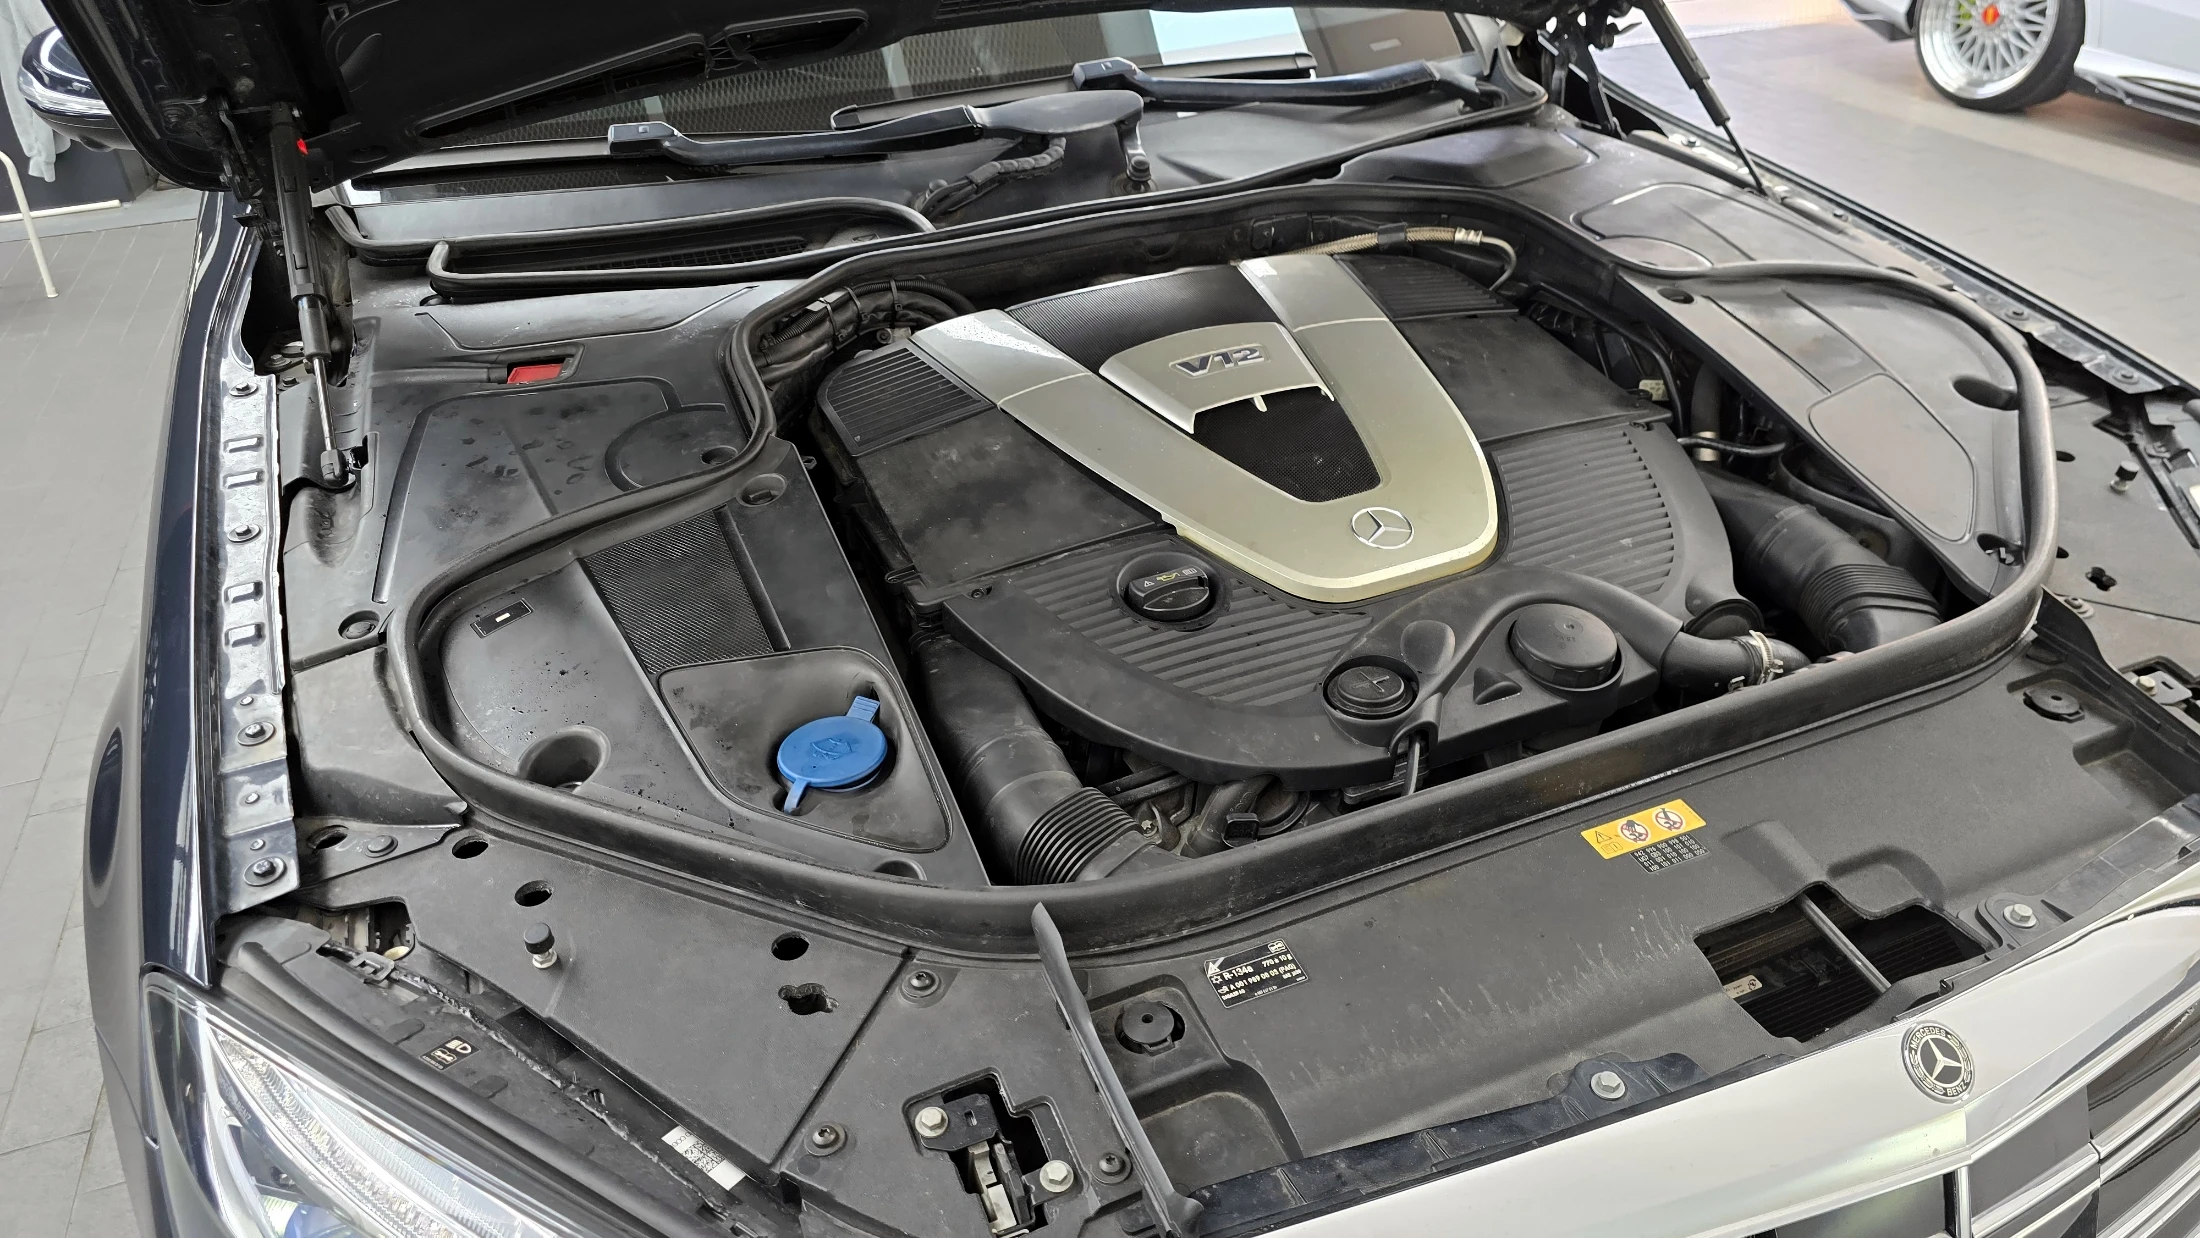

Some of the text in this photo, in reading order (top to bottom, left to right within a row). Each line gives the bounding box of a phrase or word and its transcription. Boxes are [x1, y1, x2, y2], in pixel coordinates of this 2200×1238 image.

[1176, 348, 1265, 377] V12
[1910, 1026, 1946, 1050] MERCEDES
[1946, 1081, 1967, 1097] BENZ
